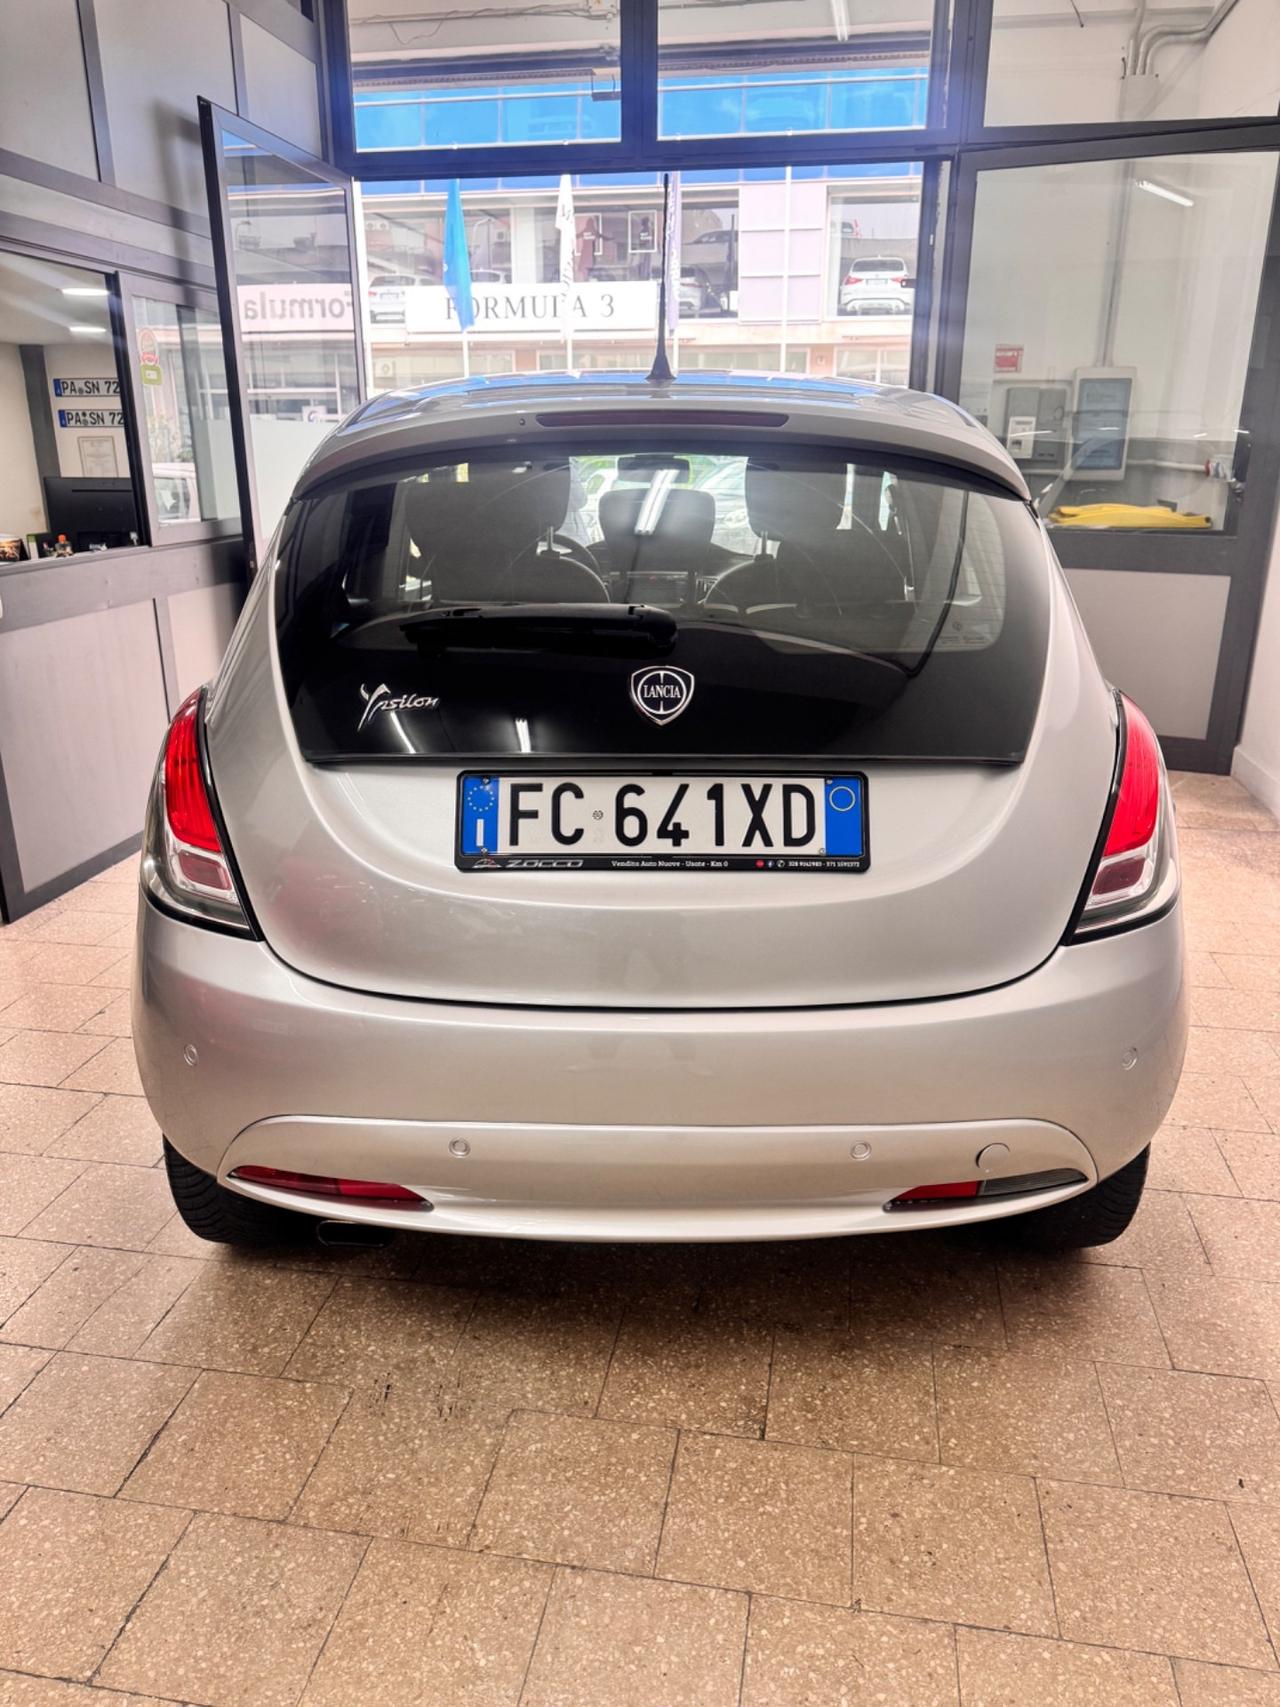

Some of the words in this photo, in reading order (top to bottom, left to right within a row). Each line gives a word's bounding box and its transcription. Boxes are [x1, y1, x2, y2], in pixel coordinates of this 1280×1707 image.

[600, 293, 615, 318] 3
[61, 381, 77, 395] PA
[84, 379, 101, 394] SN
[66, 412, 82, 425] PA
[89, 411, 105, 425] SN
[643, 684, 681, 698] LANCIA
[356, 683, 439, 732] Ypsilon
[509, 782, 584, 847] FC
[614, 782, 817, 848] 641XD
[505, 859, 584, 868] ZOCCO
